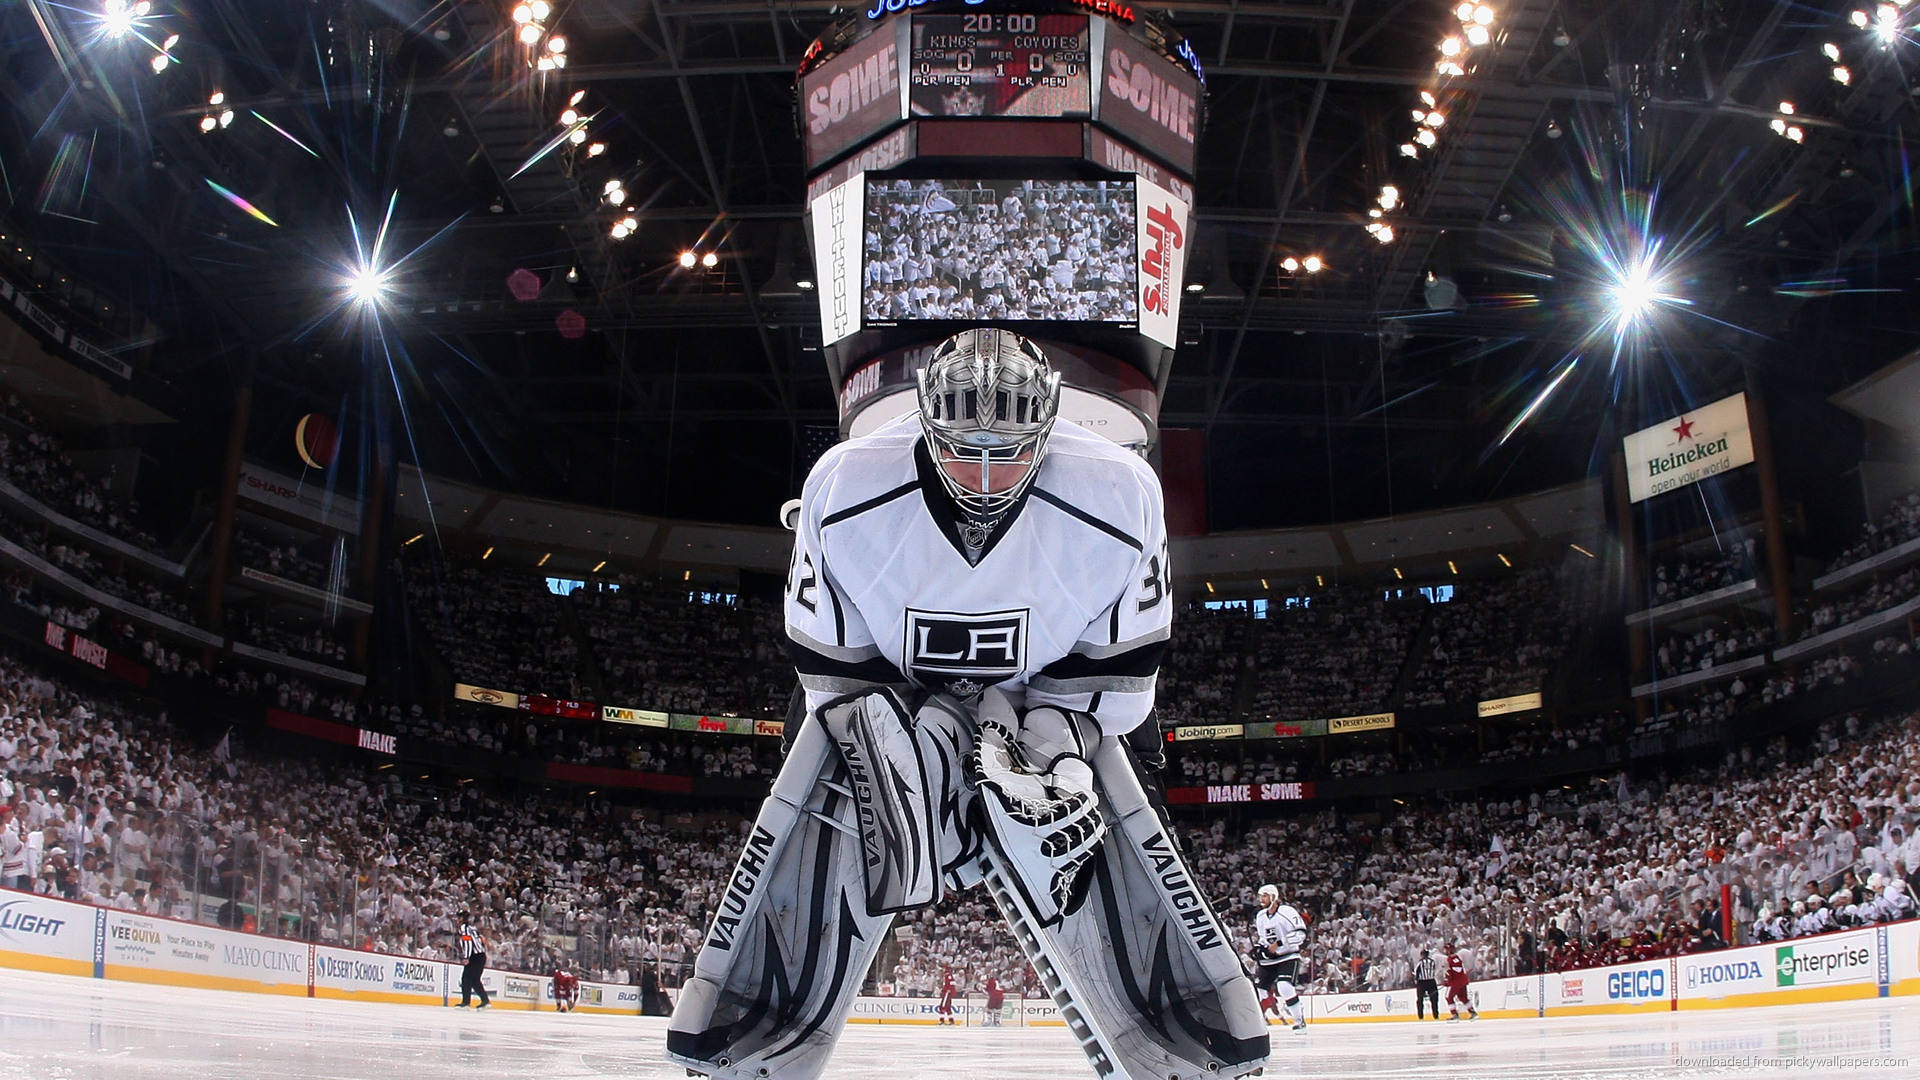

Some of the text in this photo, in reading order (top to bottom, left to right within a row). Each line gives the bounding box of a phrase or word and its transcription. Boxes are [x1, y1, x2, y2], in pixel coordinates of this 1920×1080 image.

[964, 14, 1036, 33] 20:00
[930, 35, 1078, 49] KINGS COYOTES
[913, 51, 1086, 72] SOG 0 PER 0 SOG
[921, 62, 1078, 77] 0 1 0
[810, 43, 898, 135] SOME
[915, 76, 1067, 87] PLR PEN PLR PEN
[1108, 47, 1196, 145] SOME
[1105, 139, 1159, 183] MAKE
[830, 184, 848, 338] WHITEOUT
[1648, 437, 1728, 476] Heineken
[247, 476, 297, 499] SHARP
[1650, 456, 1731, 495] open your world
[916, 624, 1018, 662] LA
[605, 708, 634, 720] WM
[1342, 716, 1390, 727] DESERT SCHOOLS
[359, 728, 397, 755] MAKE
[1180, 726, 1234, 738] Jobing.com
[839, 741, 881, 868] VAUGHN
[1207, 783, 1303, 803] MAKE SOME
[707, 825, 776, 951] VAUGHN
[1141, 831, 1224, 951] VAUGHN
[0, 909, 66, 936] LIGHT
[95, 908, 106, 962] Reebok
[224, 944, 302, 974] MAYO CLINIC
[1780, 945, 1869, 977] enterprise
[1878, 927, 1888, 981] Reebok
[327, 956, 384, 983] DESERT SCHOOLS
[1608, 968, 1664, 998] GEICO
[1699, 961, 1763, 985] HONDA
[854, 1003, 900, 1014] CLINIC
[1348, 1002, 1372, 1013] verizon
